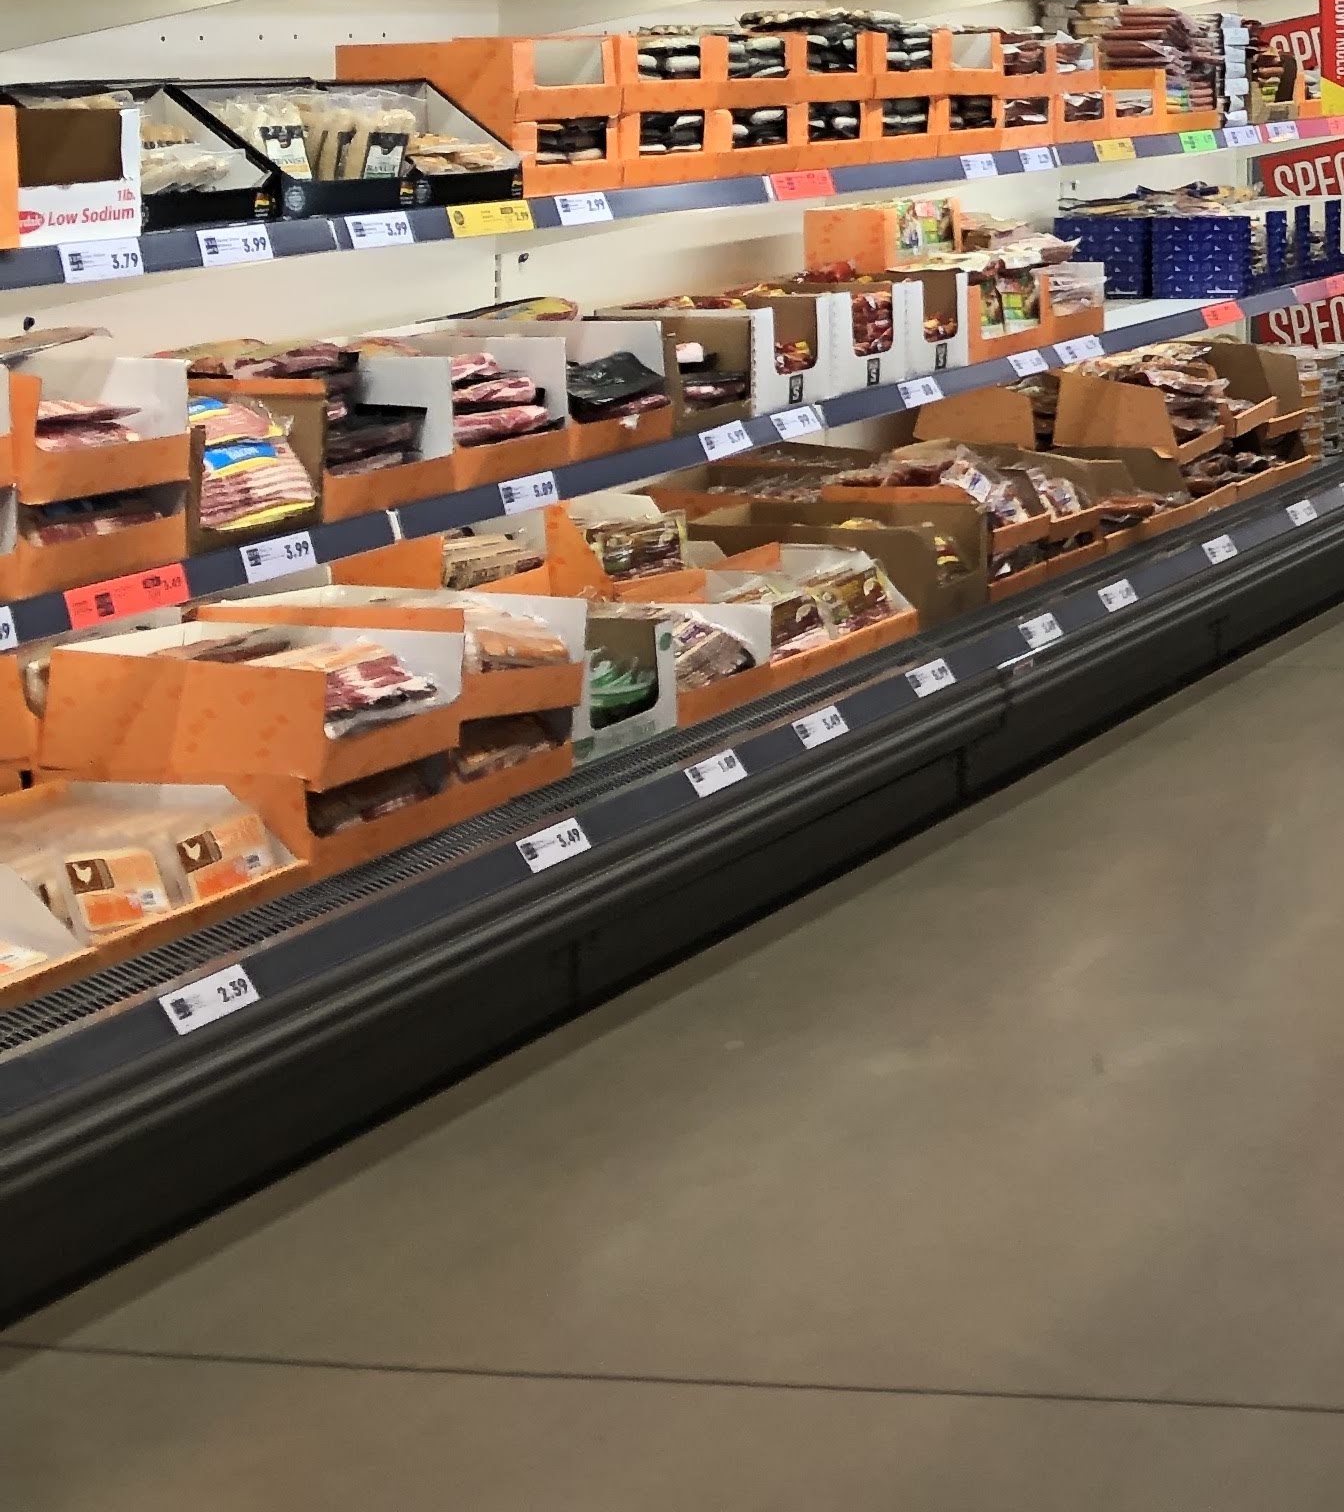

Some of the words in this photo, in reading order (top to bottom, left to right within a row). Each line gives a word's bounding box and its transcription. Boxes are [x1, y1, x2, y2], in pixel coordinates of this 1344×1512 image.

[48, 211, 78, 226] Low
[82, 205, 134, 223] Sodium
[384, 221, 408, 238] 3.99
[241, 236, 267, 254] 3.99
[110, 253, 140, 271] 3.79
[284, 540, 310, 562] 3.99
[216, 977, 249, 1004] 2.39
